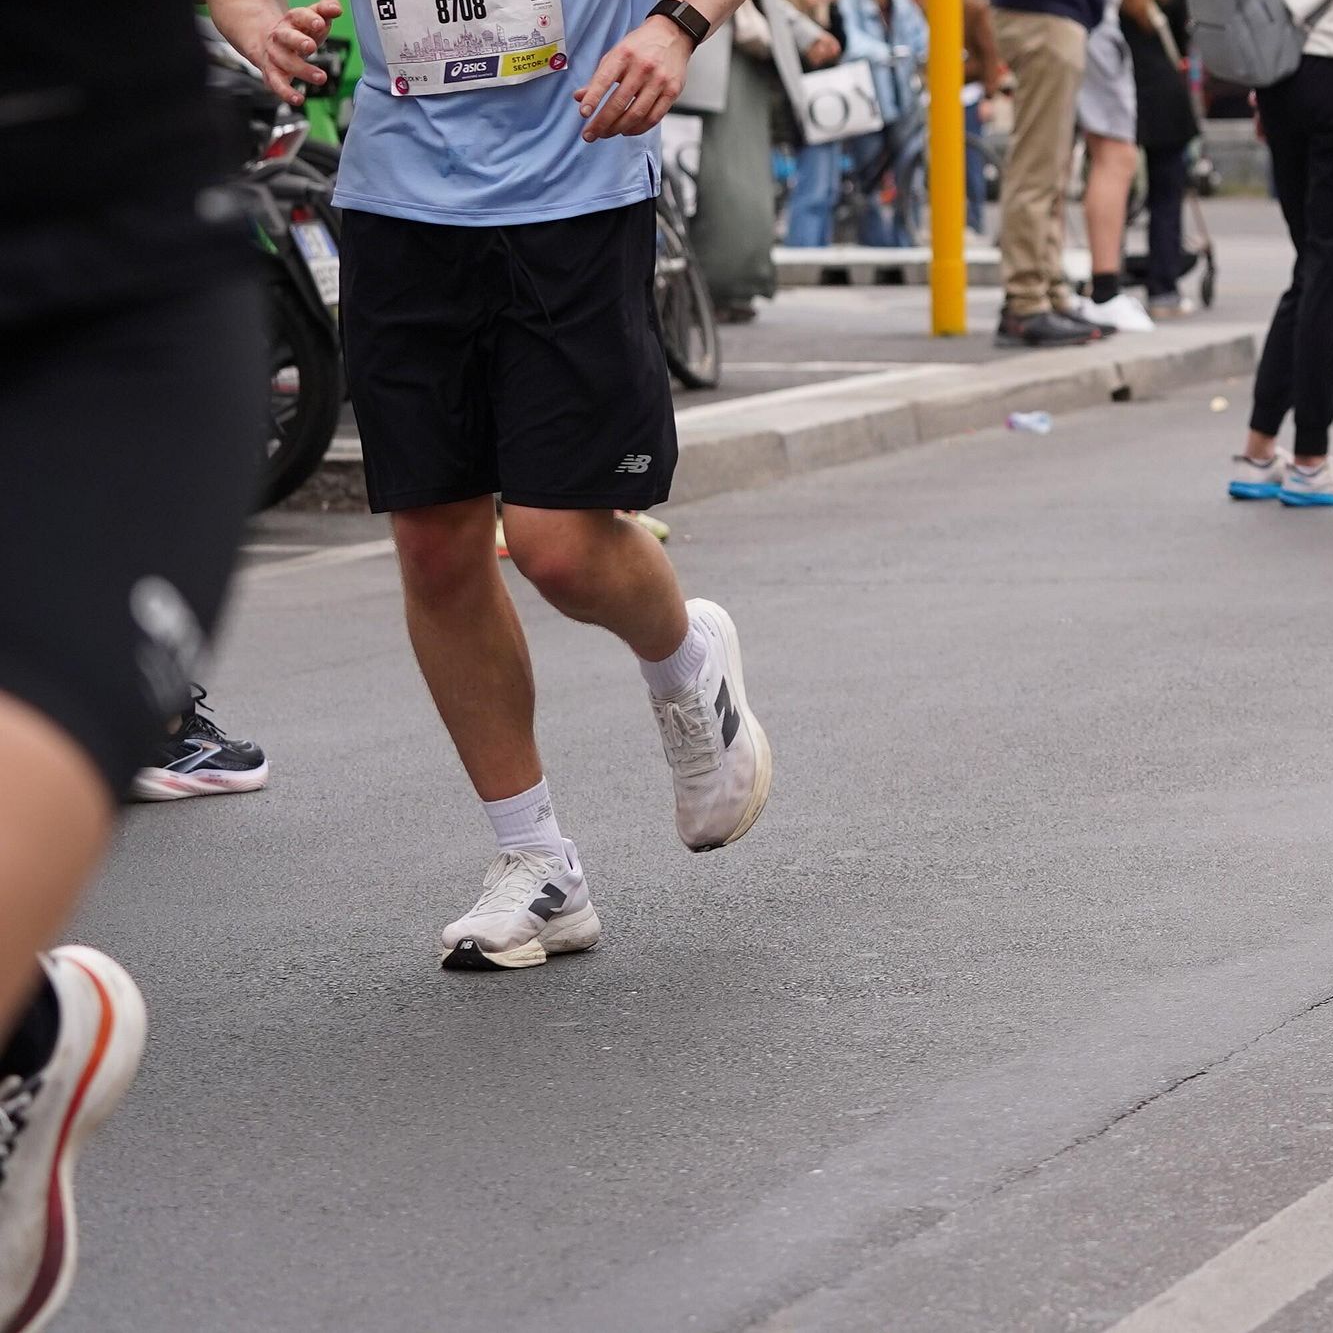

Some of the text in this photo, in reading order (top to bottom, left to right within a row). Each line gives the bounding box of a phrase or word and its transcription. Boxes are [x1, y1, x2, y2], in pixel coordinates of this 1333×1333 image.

[511, 53, 536, 63] START
[462, 61, 488, 74] asics
[513, 61, 544, 72] SECTOR:
[460, 940, 474, 950] NB
